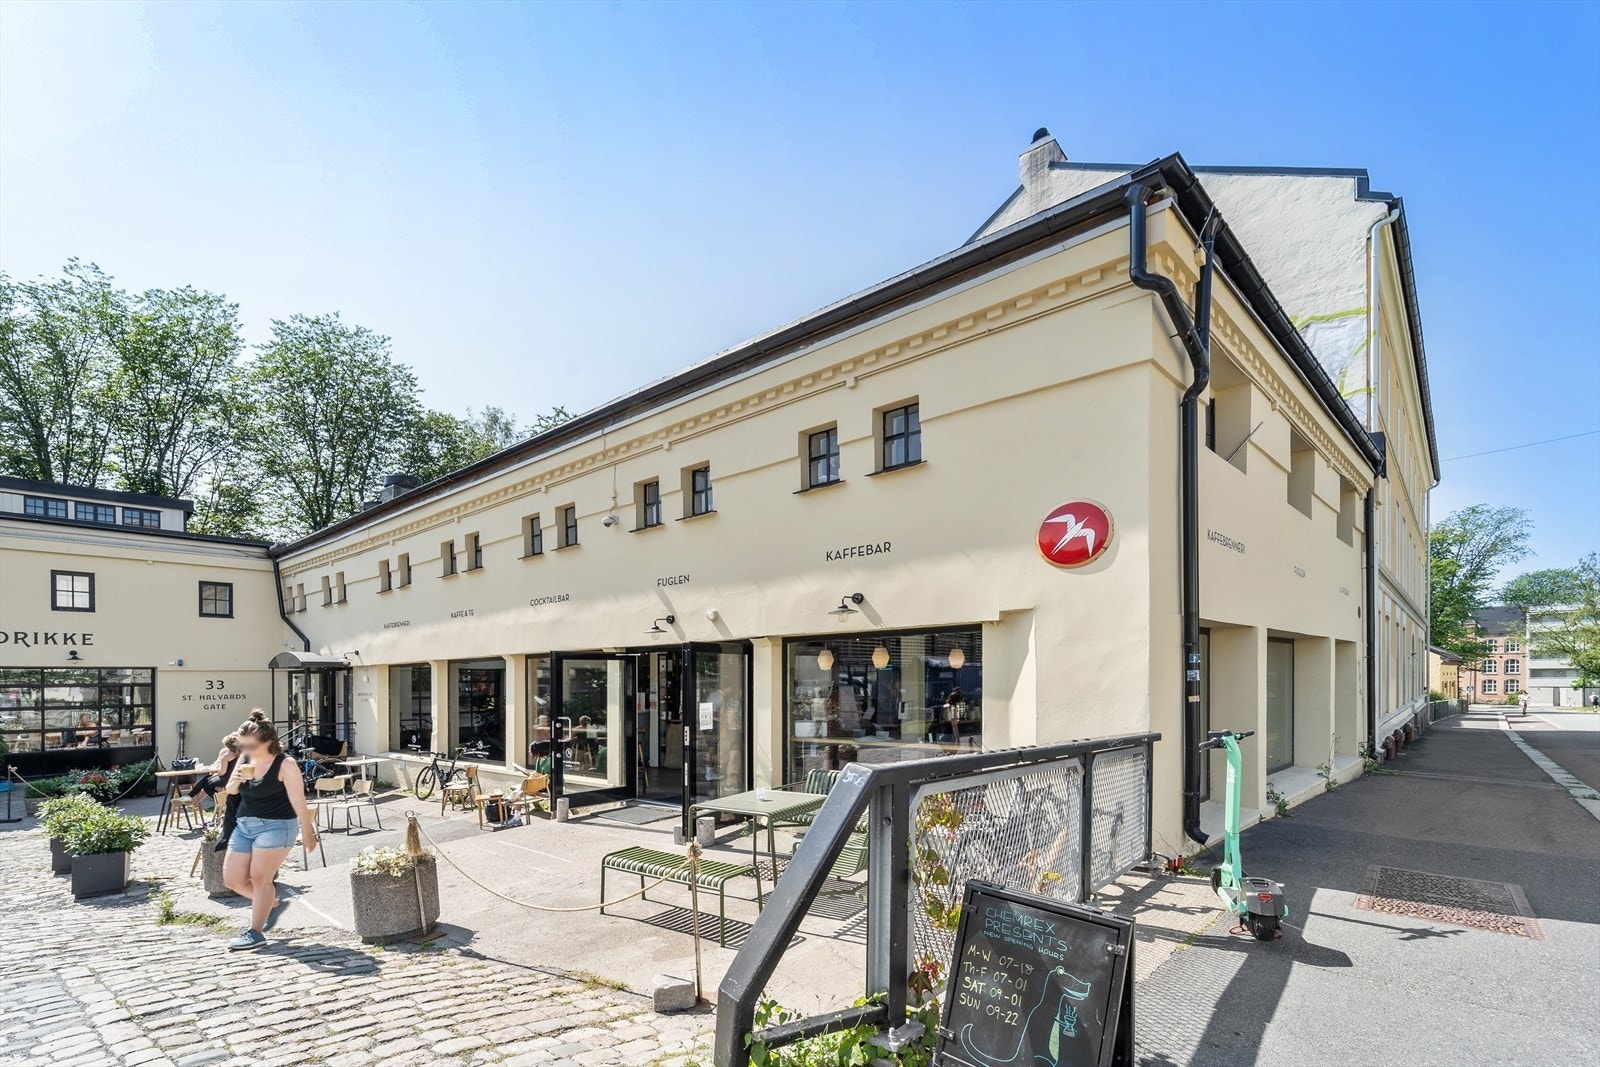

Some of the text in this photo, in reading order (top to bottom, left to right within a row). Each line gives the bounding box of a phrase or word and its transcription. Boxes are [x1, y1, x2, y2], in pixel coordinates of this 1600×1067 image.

[826, 541, 892, 561] KAFFEBAR
[657, 574, 690, 587] FUGLEN
[529, 593, 570, 607] COCKTAILBAR
[205, 680, 225, 690] 33
[985, 907, 1055, 935] CHEMREX
[967, 944, 991, 962] M-W
[983, 930, 1065, 961] NEW OPENING HOURS
[963, 961, 1027, 992] Th-F 07-01
[962, 976, 1022, 1008] SAT 09-01
[959, 992, 1018, 1026] SUN 09-22
